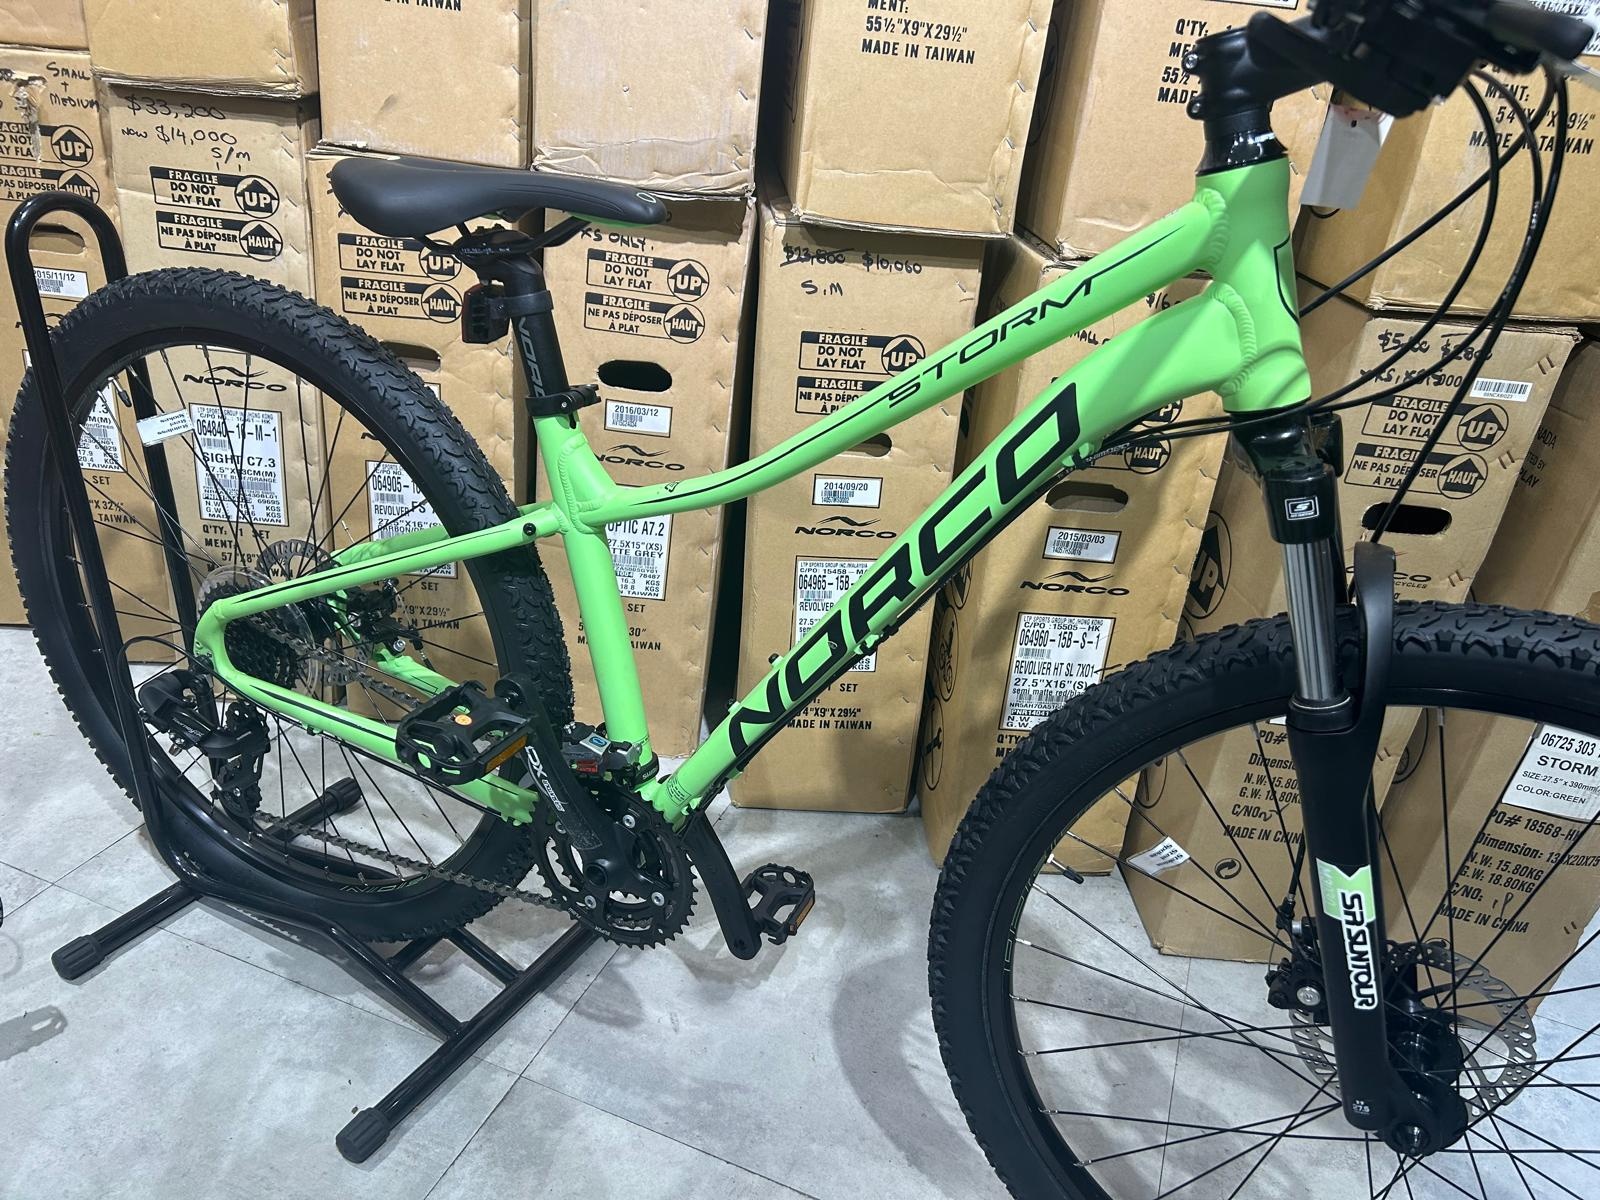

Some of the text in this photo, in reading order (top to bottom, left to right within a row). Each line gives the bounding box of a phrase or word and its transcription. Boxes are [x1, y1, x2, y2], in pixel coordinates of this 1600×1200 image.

[1176, 19, 1208, 36] Q'TY:
[862, 39, 975, 64] MADE IN TAIWAN
[127, 96, 226, 120] $33,200
[157, 125, 237, 145] $14,000
[60, 141, 85, 156] UP
[168, 170, 219, 184] FRAGILE
[18, 179, 56, 191] DÉPOSER
[66, 184, 91, 197] HAUT
[170, 181, 216, 196] DO NOT
[172, 193, 222, 208] LAY FLAT
[244, 192, 271, 207] UP
[174, 214, 223, 229] FRAGILE
[161, 226, 238, 243] NE PAS DÉPOSER
[247, 235, 273, 249] HAUT
[185, 238, 216, 252] À PLAT
[356, 236, 404, 249] FRAGILE
[356, 248, 401, 261] DO NOT
[605, 252, 654, 266] FRAGILE
[357, 259, 405, 272] LAY FLAT
[429, 256, 454, 271] UP
[605, 263, 649, 278] DO NOT
[358, 279, 406, 292] FRAGILE
[604, 275, 652, 290] LAY FLAT
[675, 274, 702, 290] UP
[345, 291, 420, 305] NE PAS DÉPOSER
[429, 300, 455, 311] HAUT
[602, 295, 650, 310] FRAGILE
[367, 303, 399, 315] À PLAT
[588, 308, 662, 325] NE PAS DÉPOSER
[609, 322, 639, 333] À PLAT
[671, 318, 697, 331] HAUT
[818, 334, 868, 346] FRAGILE
[889, 278, 1093, 409] STORM
[818, 346, 863, 357] DO NOT
[817, 358, 866, 370] LAY FLAT
[890, 352, 918, 367] UP
[183, 374, 287, 392] NORCO
[815, 379, 863, 391] FRAGILE
[800, 391, 832, 402] NE PAS
[614, 404, 659, 417] 2016/03/12
[1393, 397, 1448, 412] FRAGILE
[1388, 410, 1440, 425] DO NOT
[1382, 423, 1408, 435] LAY
[1466, 420, 1498, 439] UP
[203, 452, 276, 468] SIGHT C7.3
[1134, 447, 1162, 461] HAUT
[1353, 460, 1366, 471] NE
[1370, 462, 1390, 473] PAS
[92, 475, 110, 485] SET
[1373, 473, 1381, 485] À
[1448, 470, 1478, 485] HAUT
[824, 482, 869, 491] 2014/09/20
[99, 514, 136, 524] TAIWAN
[642, 521, 664, 536] A7.2
[795, 526, 897, 539] NORCO
[1057, 531, 1106, 544] 2015/03/03
[729, 381, 1081, 757] NORCO
[421, 581, 439, 591] SET
[1020, 581, 1130, 596] NORCO
[627, 603, 645, 613] SET
[1014, 660, 1051, 676] REVOLVER
[1053, 662, 1064, 676] HT
[1064, 663, 1074, 677] SL
[840, 683, 858, 693] SET
[1032, 689, 1052, 697] matte
[788, 720, 872, 730] MADE IN TAIWAN
[1259, 730, 1288, 745] PO#
[1541, 732, 1597, 757] 06725 303
[1537, 755, 1599, 777] STORM
[1515, 783, 1586, 805] COLOR:GREEN
[1491, 808, 1521, 828] PO#
[1224, 825, 1254, 840] MADE
[1258, 829, 1269, 841] IN
[1477, 832, 1543, 860] Dimension:
[1468, 851, 1544, 882] N.W: 15.80KG
[1459, 865, 1536, 894] G.W: 18.80KG
[1439, 903, 1530, 934] MADE IN CHINA
[1350, 928, 1376, 1010] SUNTOUR
